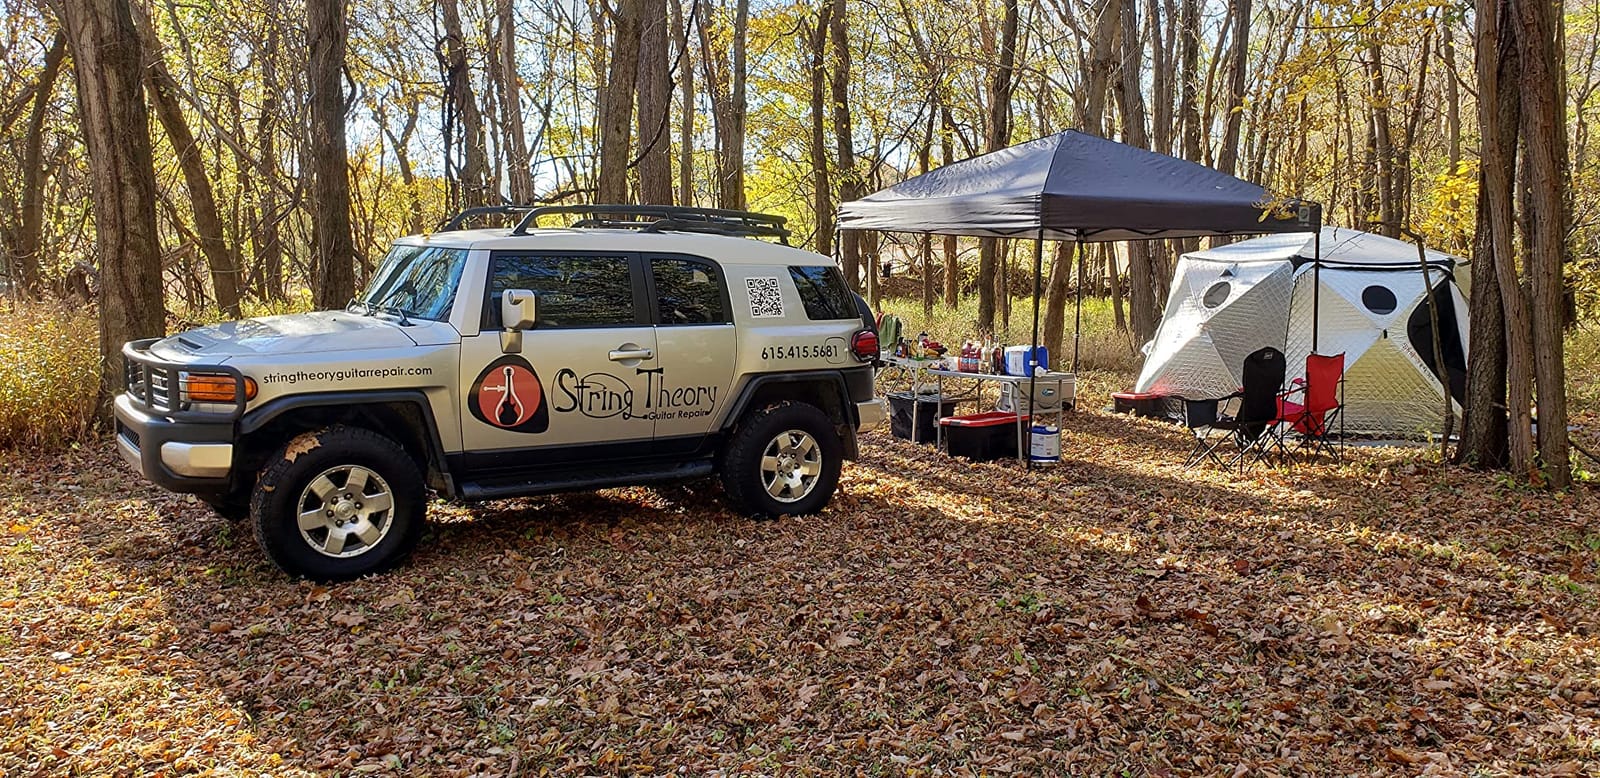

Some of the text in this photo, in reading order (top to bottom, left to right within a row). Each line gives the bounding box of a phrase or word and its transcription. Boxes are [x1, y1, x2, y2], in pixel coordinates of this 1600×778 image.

[761, 345, 838, 360] 615.415.5681
[263, 366, 433, 384] stringtheoryguitarrepair.com
[551, 367, 718, 420] String Theory
[648, 408, 706, 420] Guitar Repair
